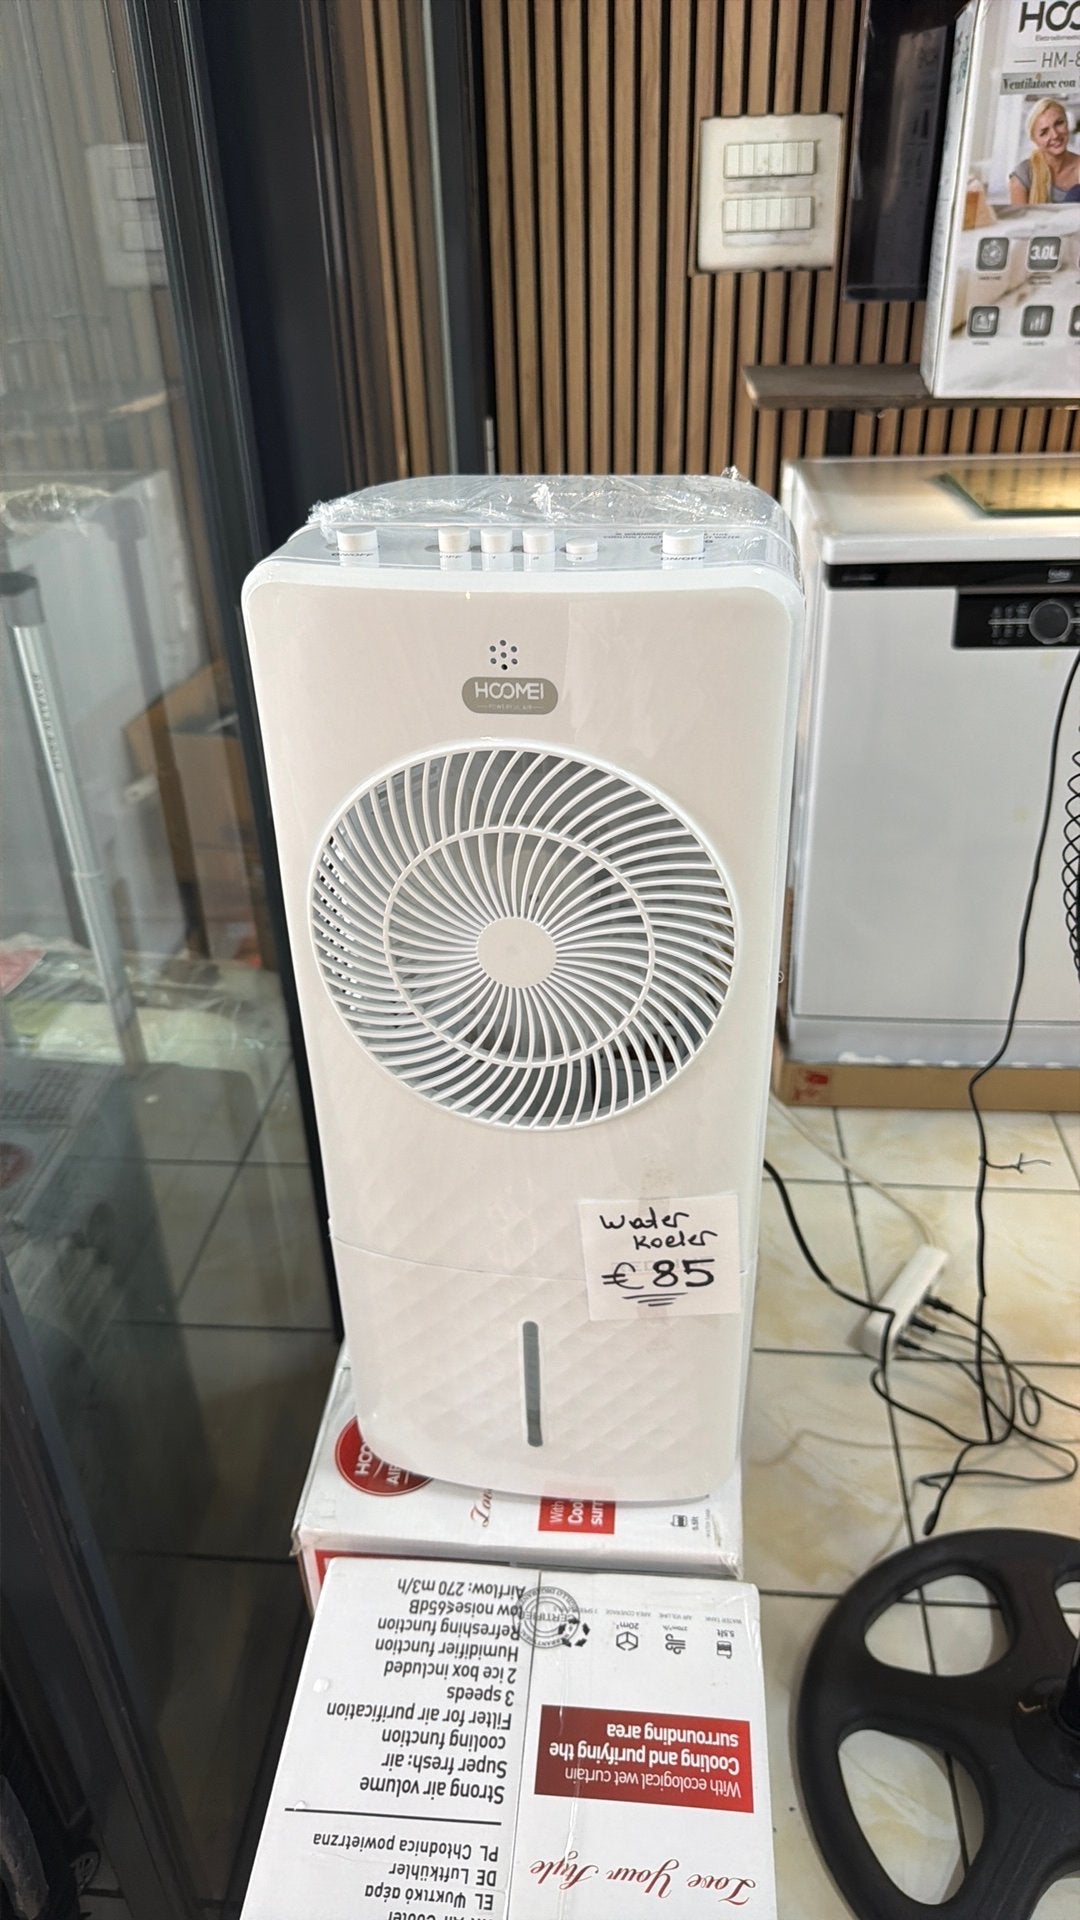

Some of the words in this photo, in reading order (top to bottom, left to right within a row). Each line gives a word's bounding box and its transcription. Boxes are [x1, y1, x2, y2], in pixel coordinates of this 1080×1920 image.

[474, 681, 544, 700] HOOMEI
[397, 1577, 436, 1595] m3/h
[438, 1580, 465, 1596] 270
[468, 1582, 526, 1599] Airflow:
[377, 1618, 437, 1636] function
[440, 1618, 521, 1641] Refreshing
[375, 1638, 435, 1657] function
[438, 1642, 519, 1662] Humidifier
[383, 1660, 449, 1680] included
[452, 1664, 480, 1682] box
[483, 1666, 504, 1683] ice
[507, 1667, 518, 1684] 2
[446, 1685, 502, 1703] speeds
[504, 1690, 515, 1707] 3
[326, 1702, 416, 1722] purification
[417, 1707, 440, 1725] air
[442, 1709, 466, 1727] for
[468, 1711, 512, 1730] Filter
[381, 1729, 446, 1750] function
[449, 1729, 506, 1752] cooling
[606, 1723, 642, 1740] area
[644, 1722, 739, 1748] surrounding
[549, 1742, 574, 1760] the
[577, 1740, 646, 1766] purifying
[649, 1749, 678, 1768] and
[381, 1753, 405, 1771] air
[408, 1754, 455, 1775] fresh:
[458, 1755, 508, 1779] Super
[681, 1749, 740, 1775] Cooling
[564, 1767, 610, 1784] curtain
[614, 1771, 639, 1786] wet
[641, 1771, 707, 1793] ecological
[359, 1776, 420, 1798] volume
[423, 1781, 447, 1800] air
[449, 1778, 505, 1805] Strong
[710, 1779, 742, 1798] With
[313, 1833, 396, 1852] powietrzna
[399, 1840, 472, 1860] Chłodnica
[480, 1845, 499, 1862] PL
[389, 1863, 469, 1884] Luftkühler
[476, 1869, 497, 1887] DE
[529, 1851, 599, 1890] Style
[606, 1859, 680, 1899] Your
[365, 1883, 401, 1903] αέρα
[405, 1888, 466, 1909] Ψυκτικό
[687, 1874, 756, 1906] Love
[475, 1893, 494, 1911] EL
